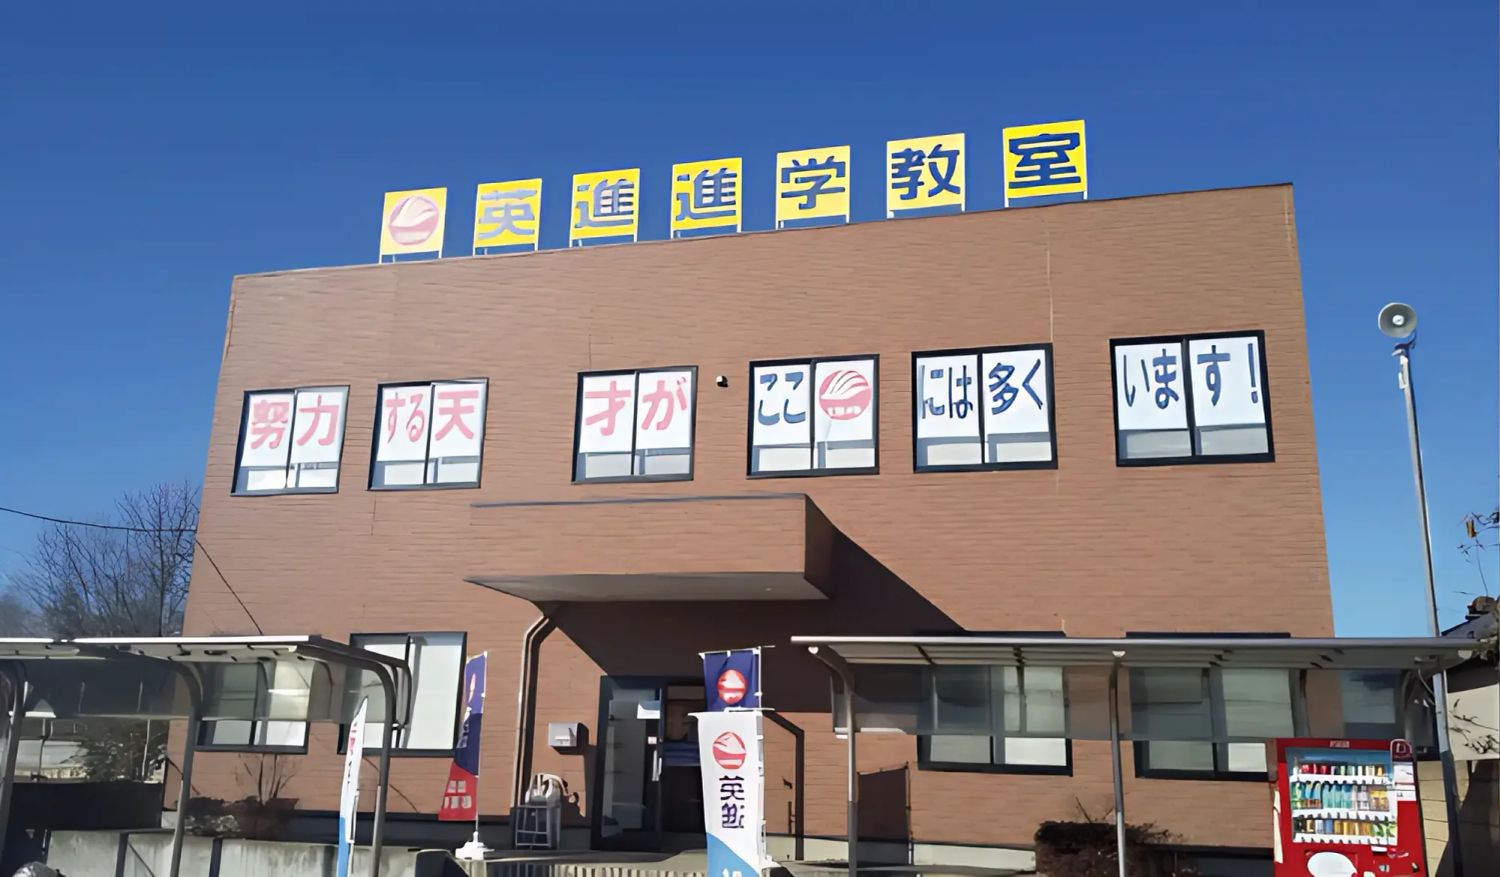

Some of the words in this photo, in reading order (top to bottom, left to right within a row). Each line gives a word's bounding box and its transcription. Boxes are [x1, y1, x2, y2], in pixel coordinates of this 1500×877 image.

[478, 131, 1081, 239] 英進進学教室
[250, 394, 339, 450] 努力
[386, 390, 480, 444] する天
[584, 376, 689, 436] 才が
[758, 371, 806, 425] ここ
[921, 358, 1044, 419] には多く
